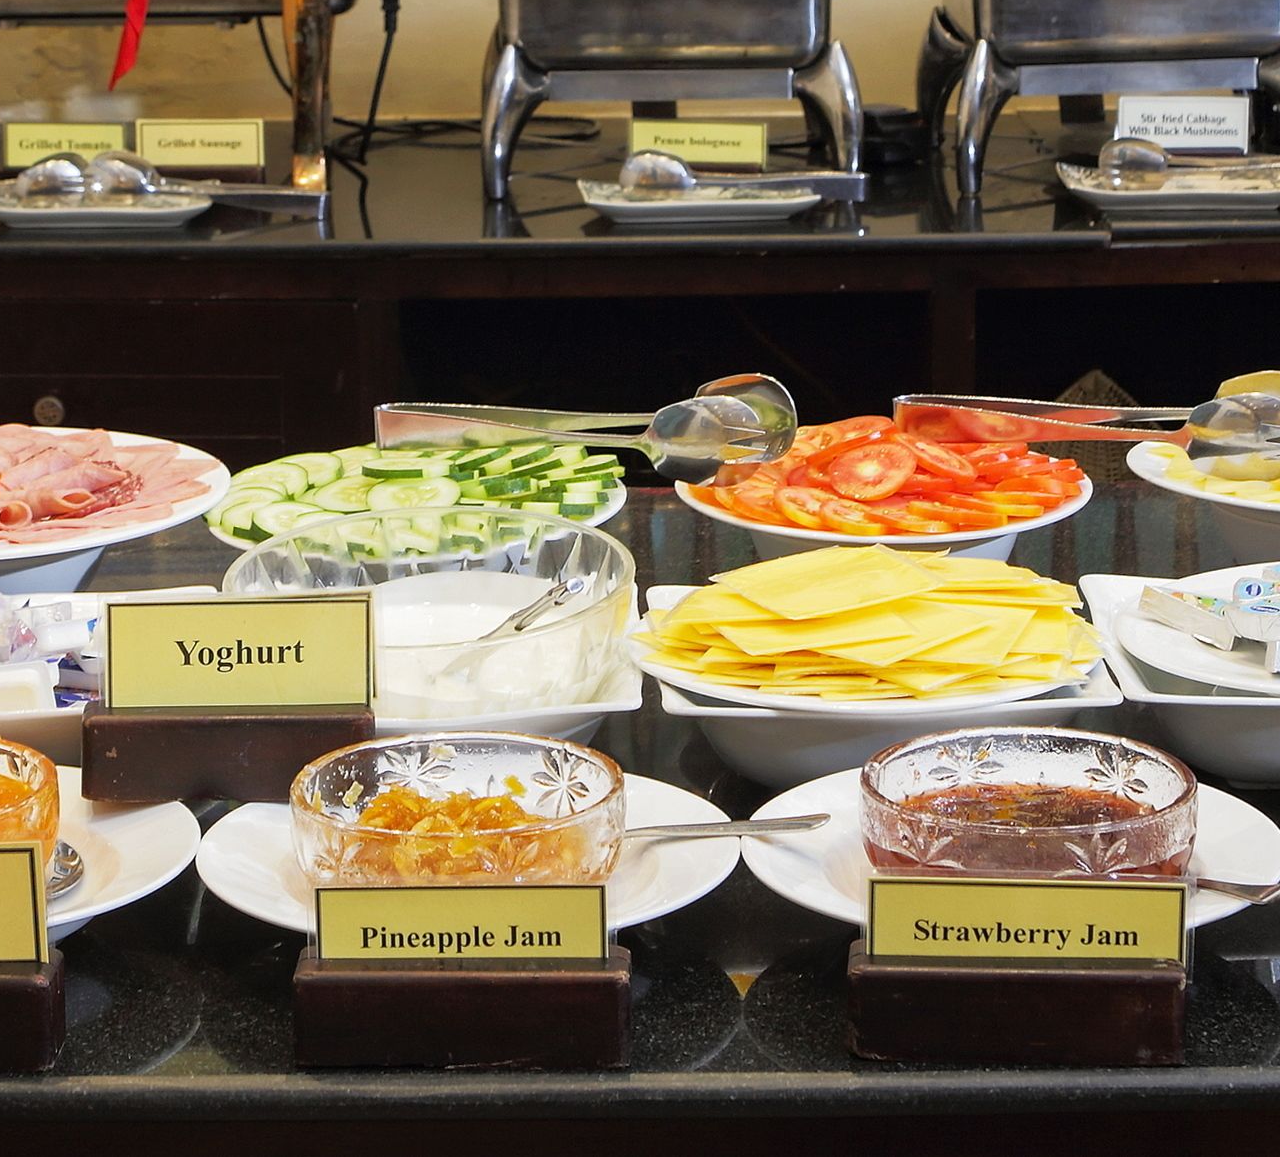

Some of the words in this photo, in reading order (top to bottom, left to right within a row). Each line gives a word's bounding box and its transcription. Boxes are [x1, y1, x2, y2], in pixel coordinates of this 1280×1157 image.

[1186, 113, 1228, 126] Cabbage
[1153, 125, 1180, 137] Black
[1182, 125, 1240, 137] Mushrooms
[19, 138, 62, 151] Grilled
[68, 139, 113, 151] Tomato
[157, 137, 197, 149] Grilled
[199, 138, 242, 150] Sausage
[653, 135, 686, 147] Penne
[175, 638, 305, 672] Yoghurt
[359, 924, 497, 953] Pineapple
[504, 924, 563, 949] Jam
[912, 918, 1072, 951] Strawberry
[1080, 923, 1140, 947] Jam
